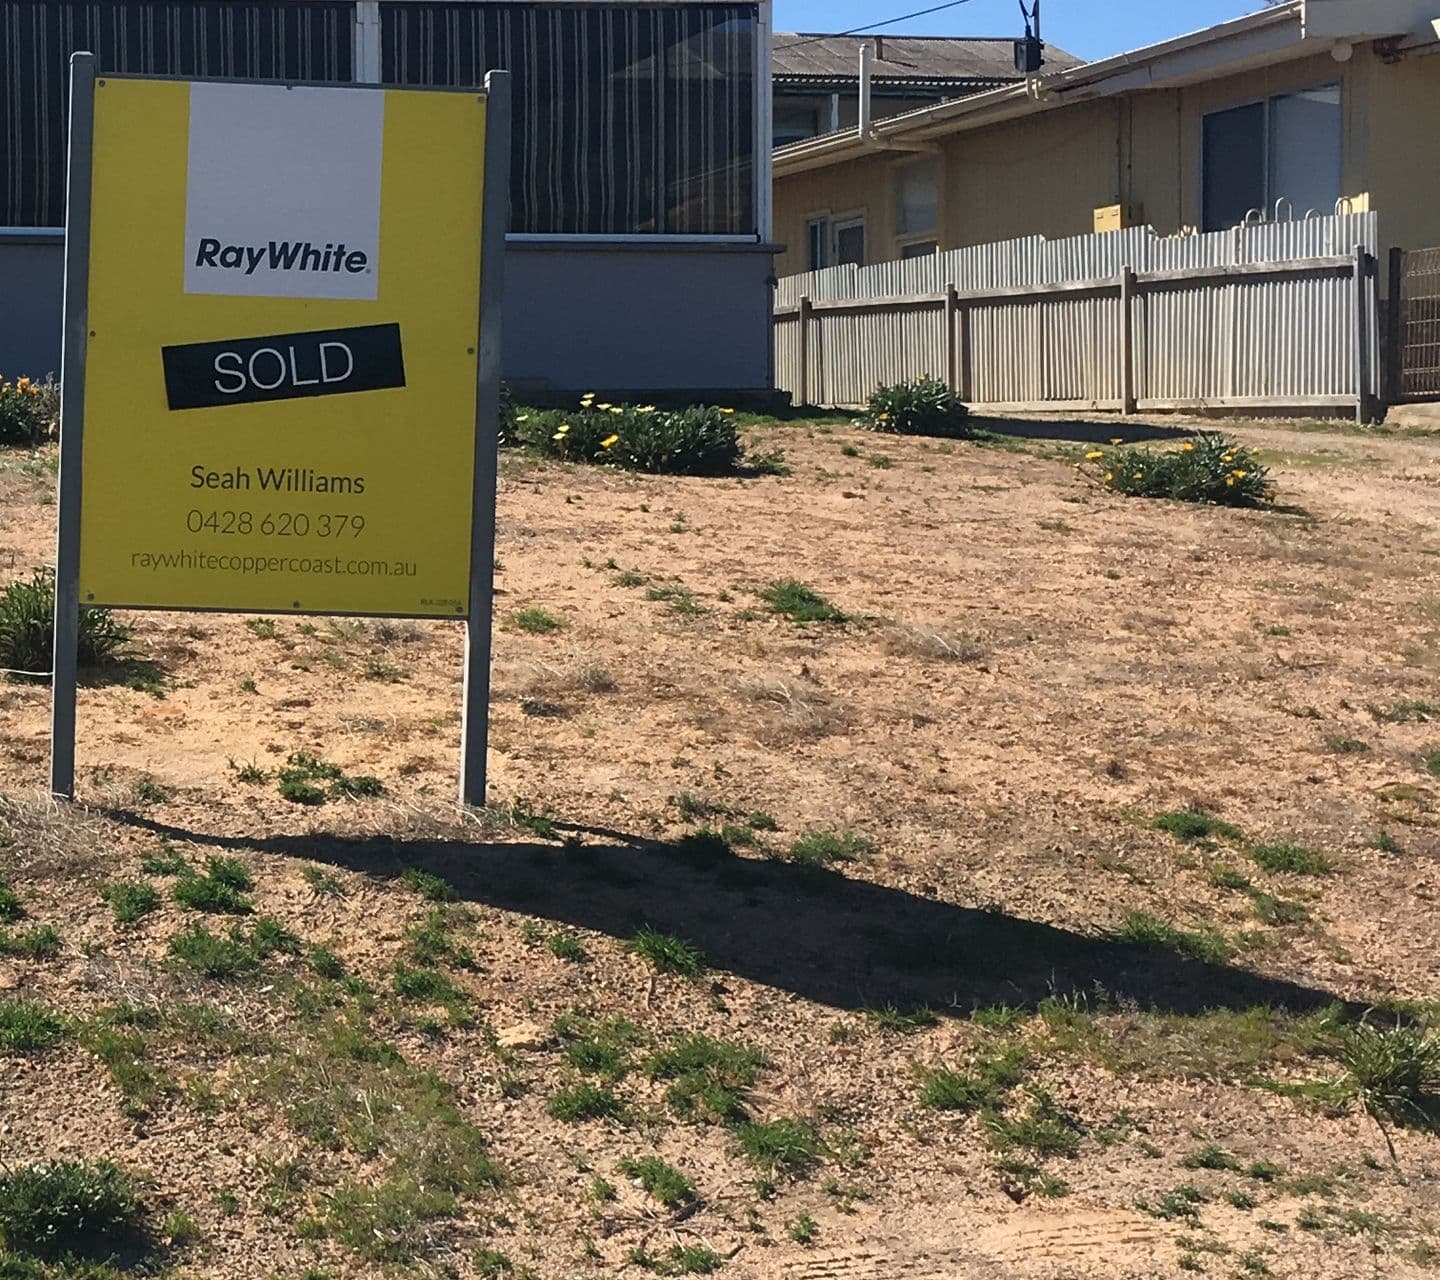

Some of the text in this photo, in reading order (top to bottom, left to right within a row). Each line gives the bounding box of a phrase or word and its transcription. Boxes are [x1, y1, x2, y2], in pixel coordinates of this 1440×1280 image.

[214, 341, 354, 394] SOLD
[190, 465, 365, 494] Seah Williams
[186, 509, 365, 538] 0428 620 379
[131, 549, 417, 577] raywhitecoppercoast.com.au
